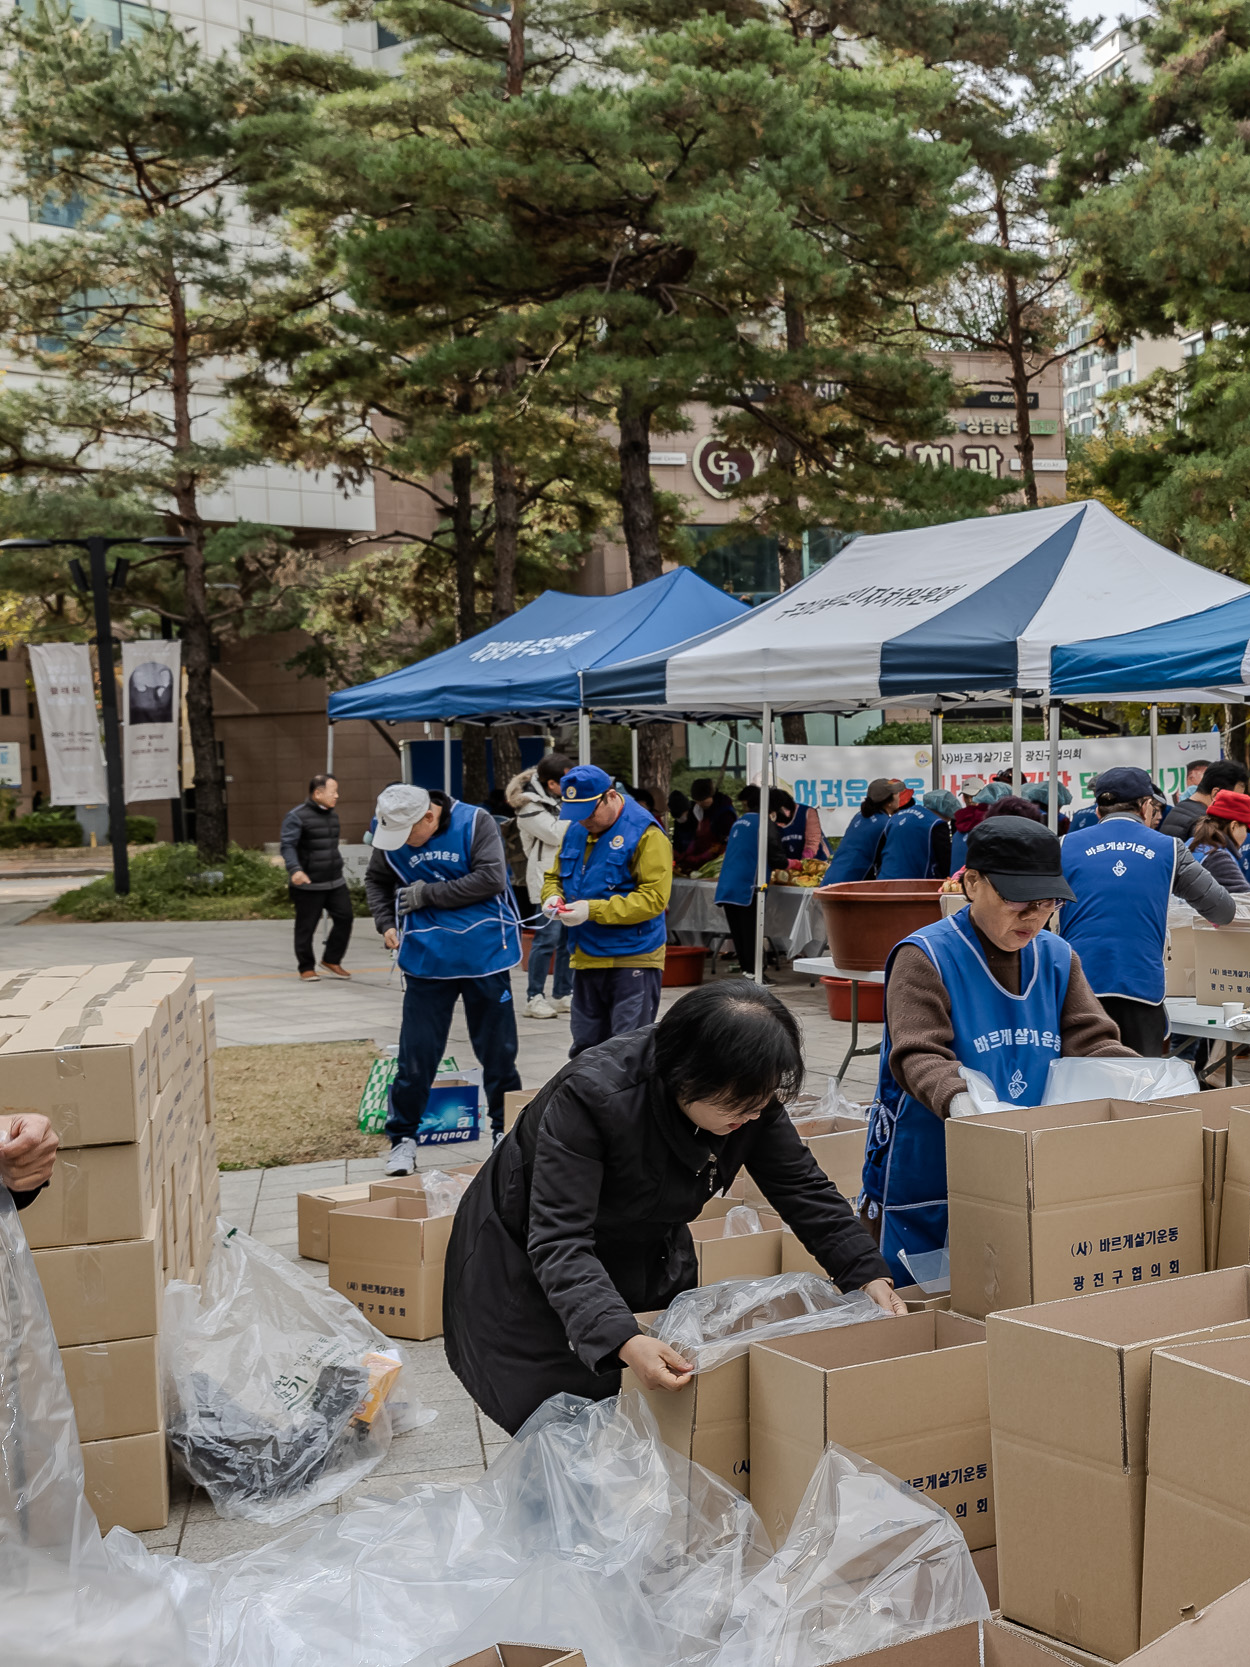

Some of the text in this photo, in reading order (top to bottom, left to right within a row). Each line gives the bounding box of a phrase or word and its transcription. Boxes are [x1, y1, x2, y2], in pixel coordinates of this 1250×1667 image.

[1085, 841, 1156, 860] 바르게살기운동
[973, 1027, 1062, 1054] 바르게살기운동
[431, 1130, 471, 1142] Double
[1070, 1226, 1179, 1258] (사) 바르게살기운동
